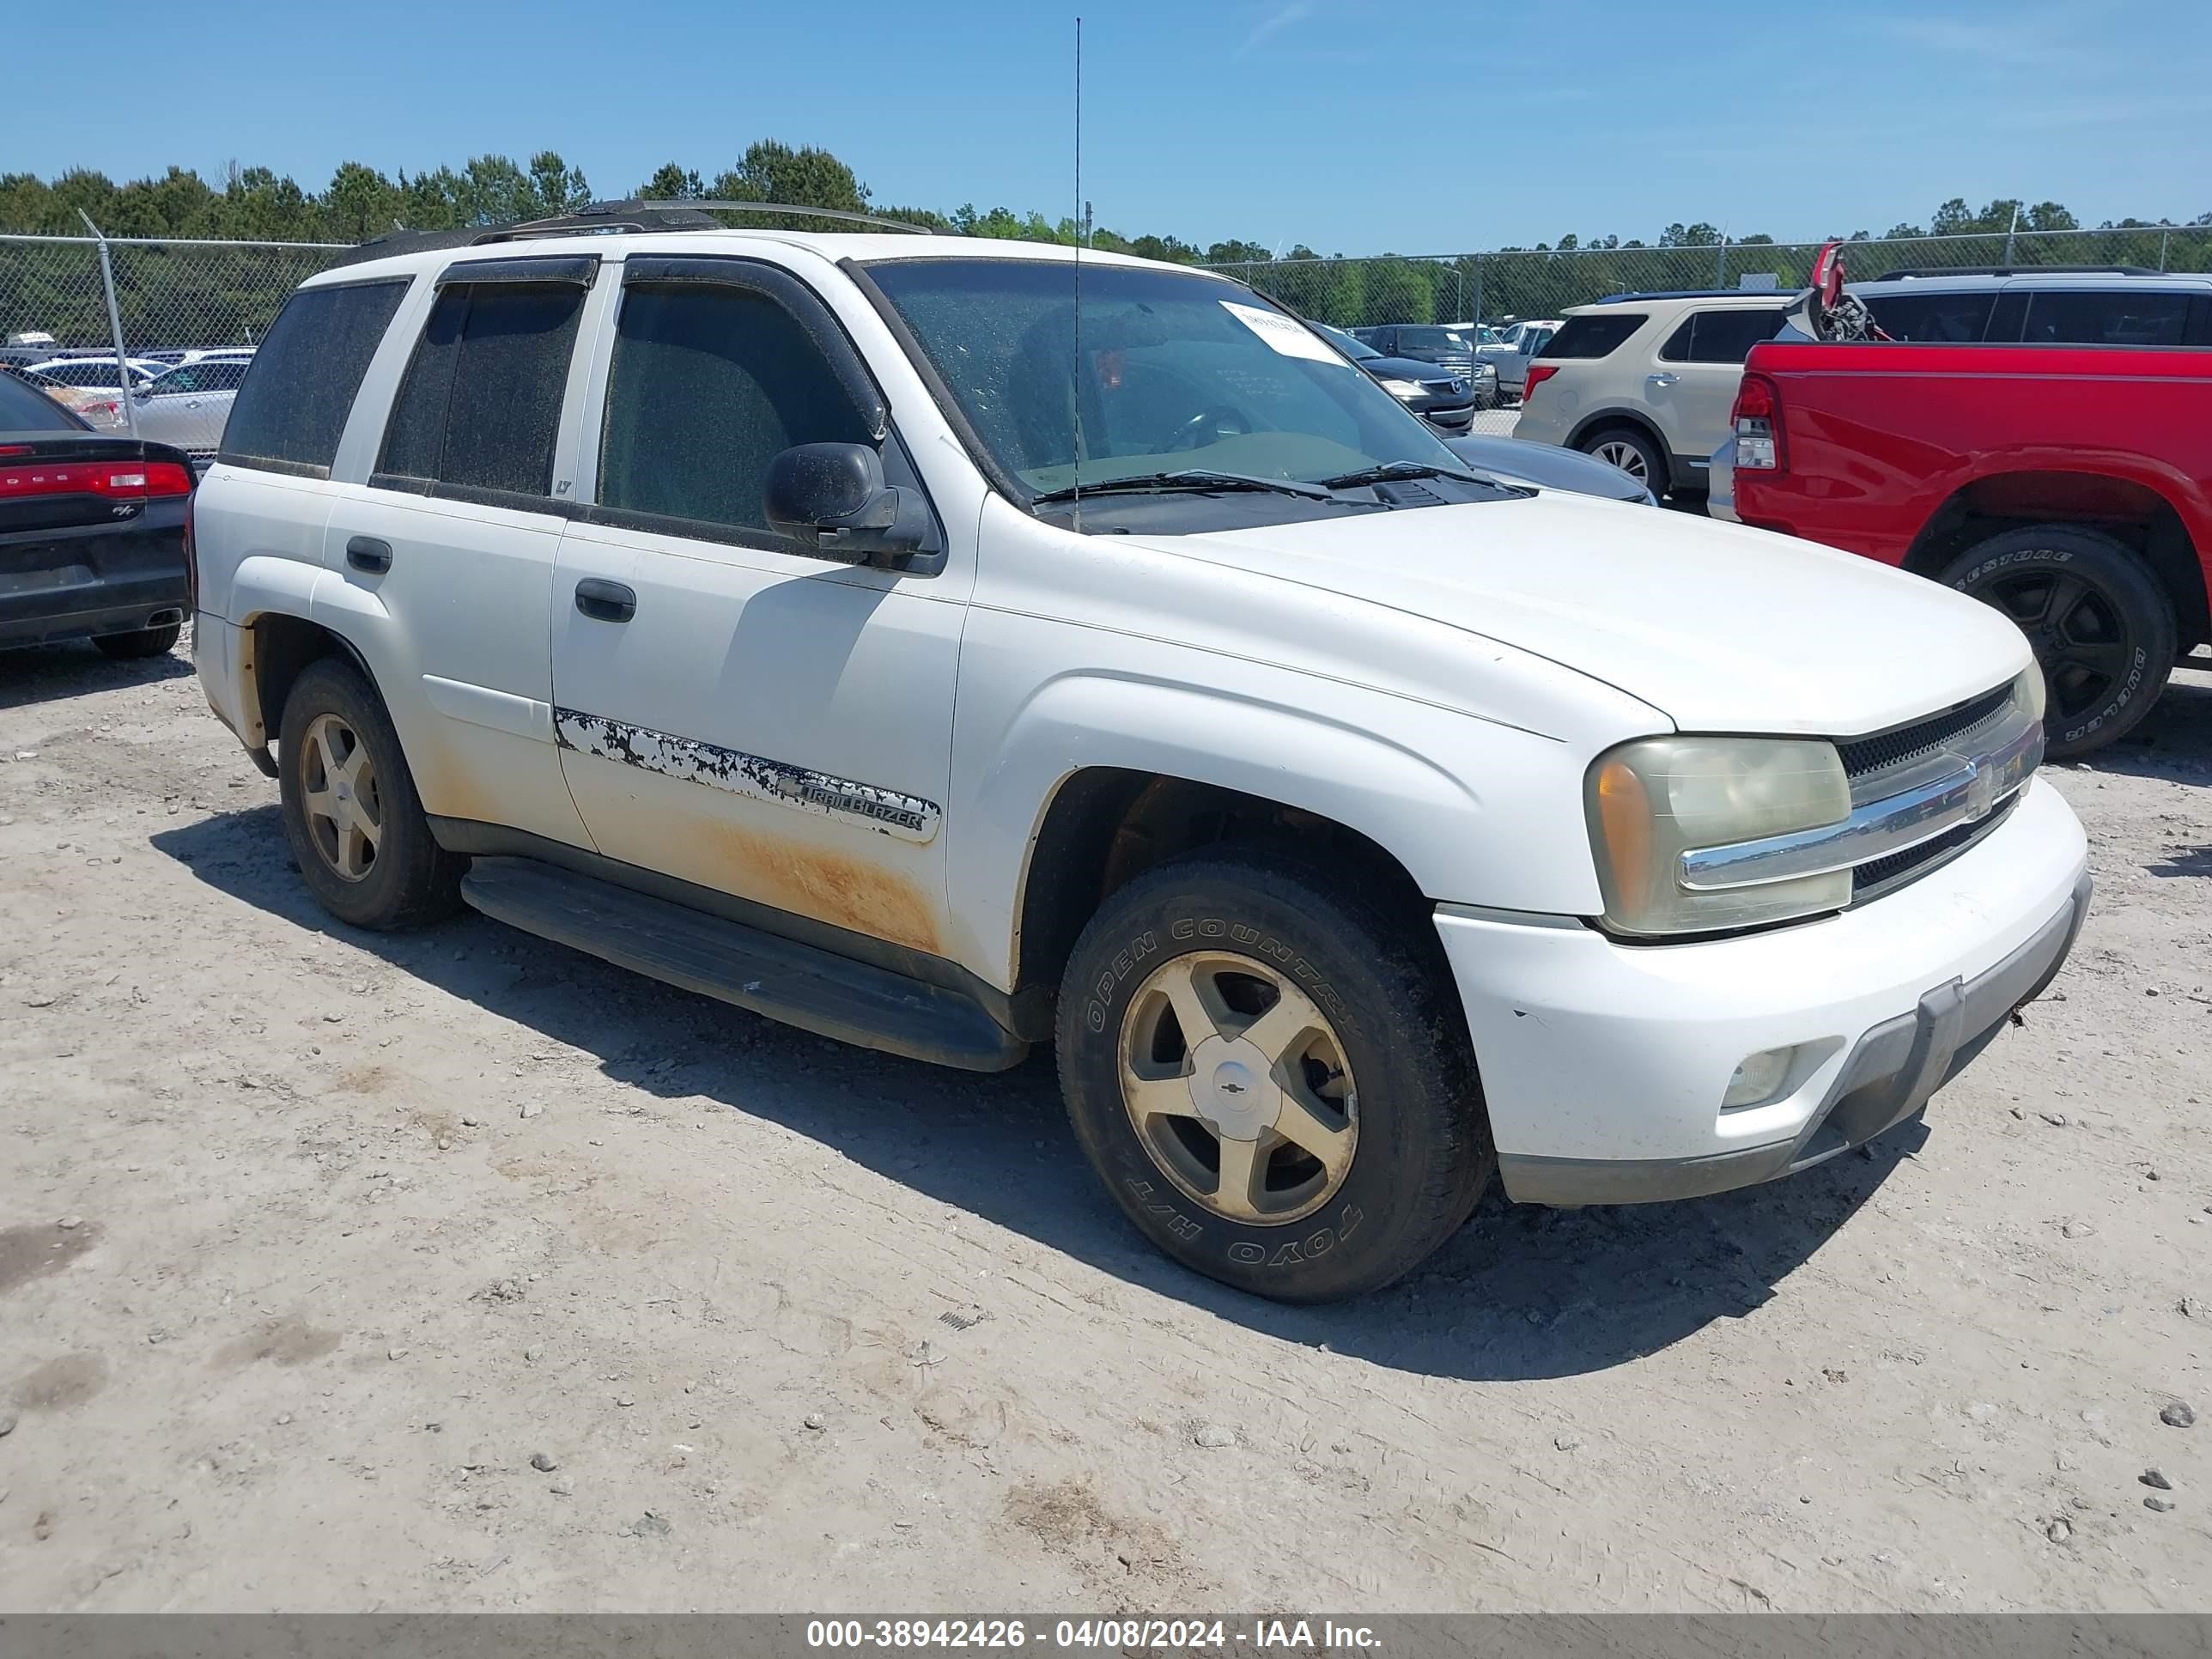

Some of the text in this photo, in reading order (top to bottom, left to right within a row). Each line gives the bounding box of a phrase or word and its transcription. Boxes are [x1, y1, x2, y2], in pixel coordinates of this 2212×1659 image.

[555, 480, 572, 495] LT
[1085, 917, 1368, 1041] OPEN COUNTRY
[1126, 1176, 1366, 1267] TOYO H/T
